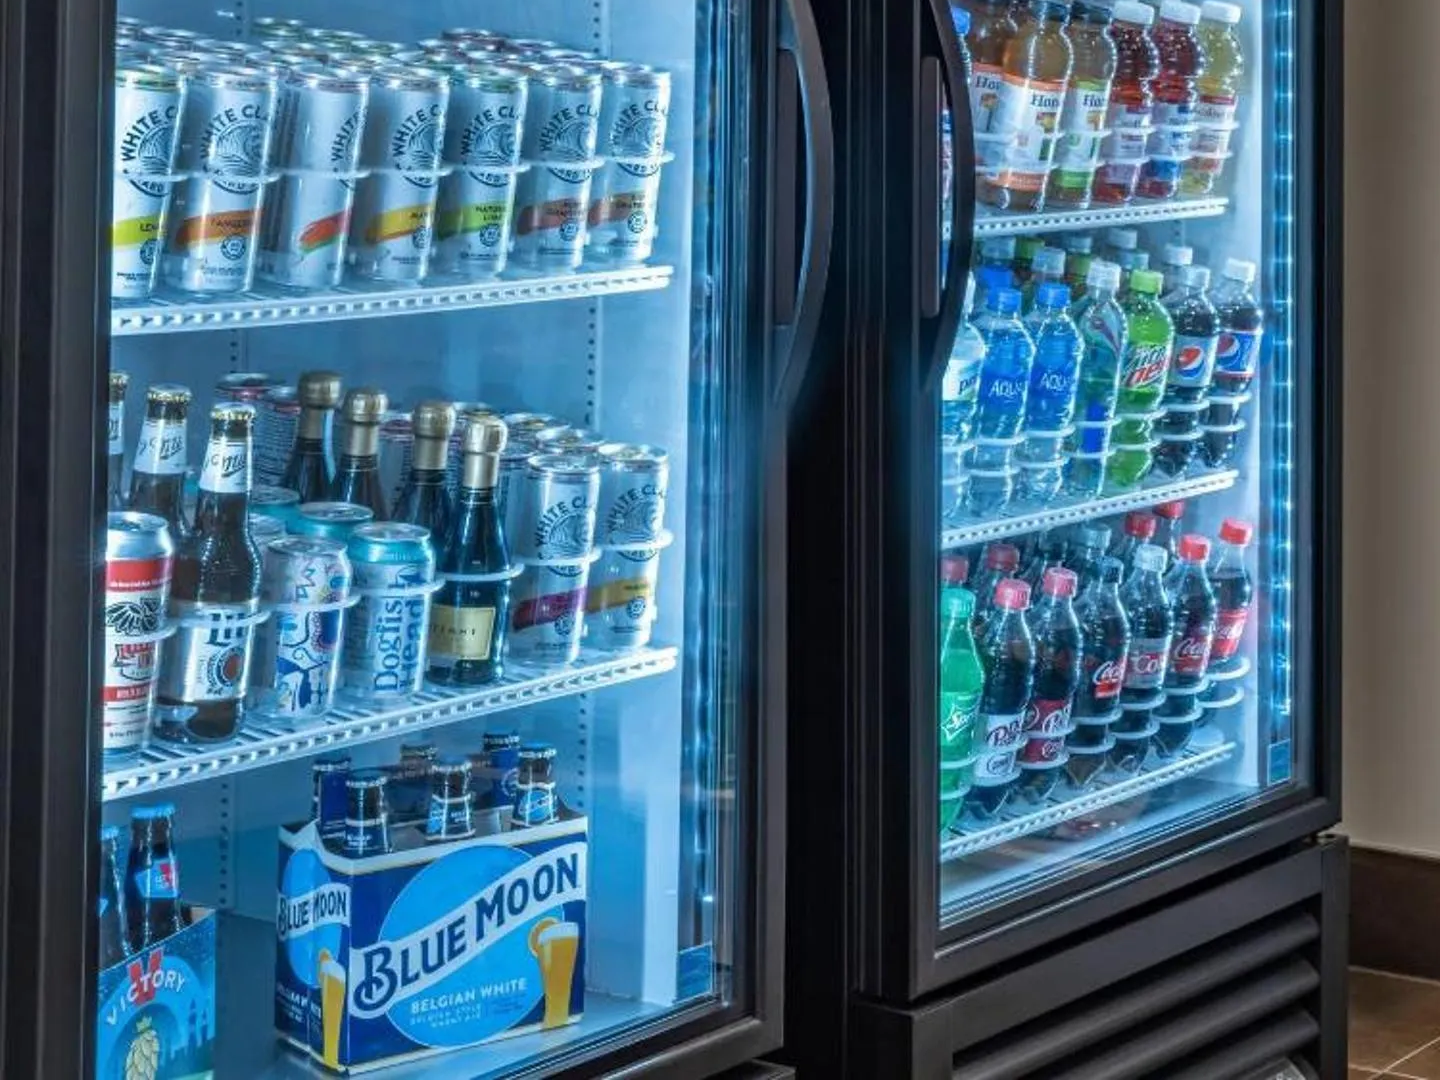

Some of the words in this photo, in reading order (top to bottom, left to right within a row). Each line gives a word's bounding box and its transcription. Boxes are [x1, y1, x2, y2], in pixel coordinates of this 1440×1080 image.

[120, 110, 159, 163] WHITE
[392, 110, 427, 159] WHITE
[278, 890, 310, 937] BLUE
[312, 887, 348, 921] MOON
[353, 926, 467, 1014] BLUE
[475, 851, 582, 939] MOON
[409, 989, 477, 1015] BELGIAN
[480, 977, 528, 998] WHITE
